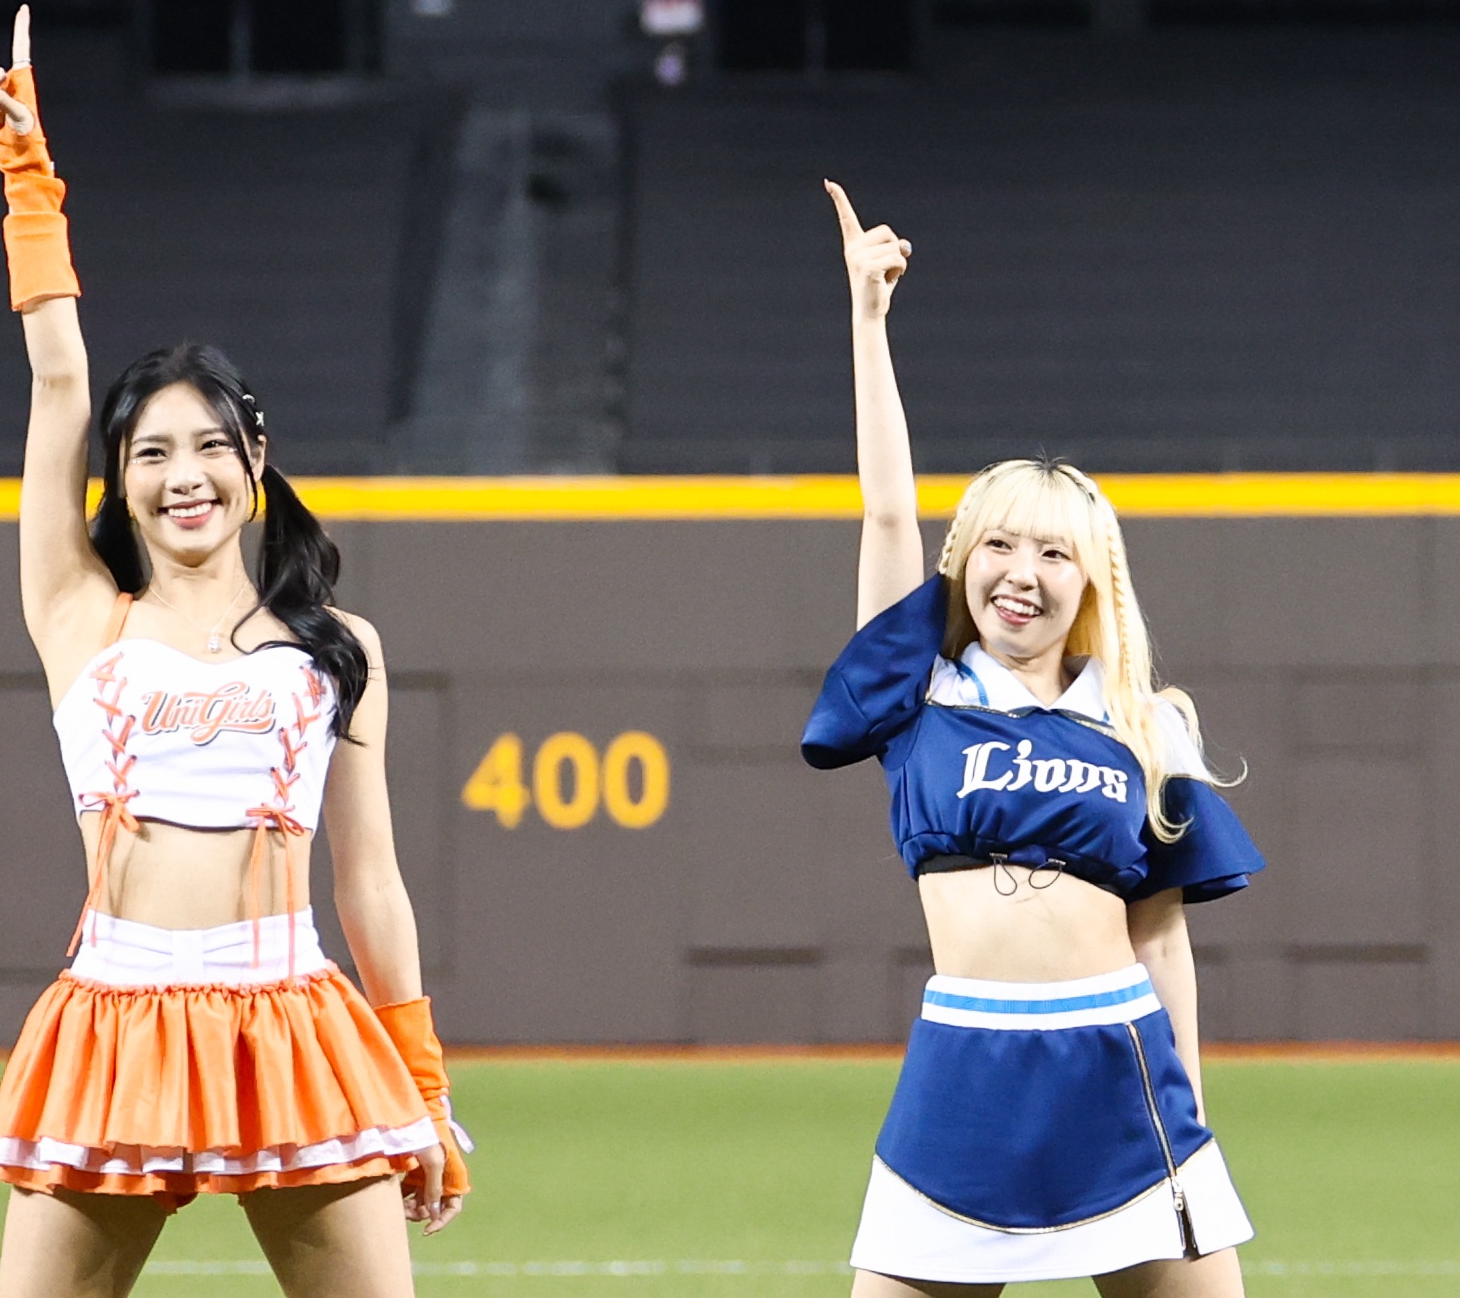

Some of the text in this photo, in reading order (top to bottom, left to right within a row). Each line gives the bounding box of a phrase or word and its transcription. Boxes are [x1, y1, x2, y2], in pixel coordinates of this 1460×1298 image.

[140, 682, 277, 745] UniGirls
[460, 729, 670, 831] 400
[956, 739, 1128, 803] Lions
